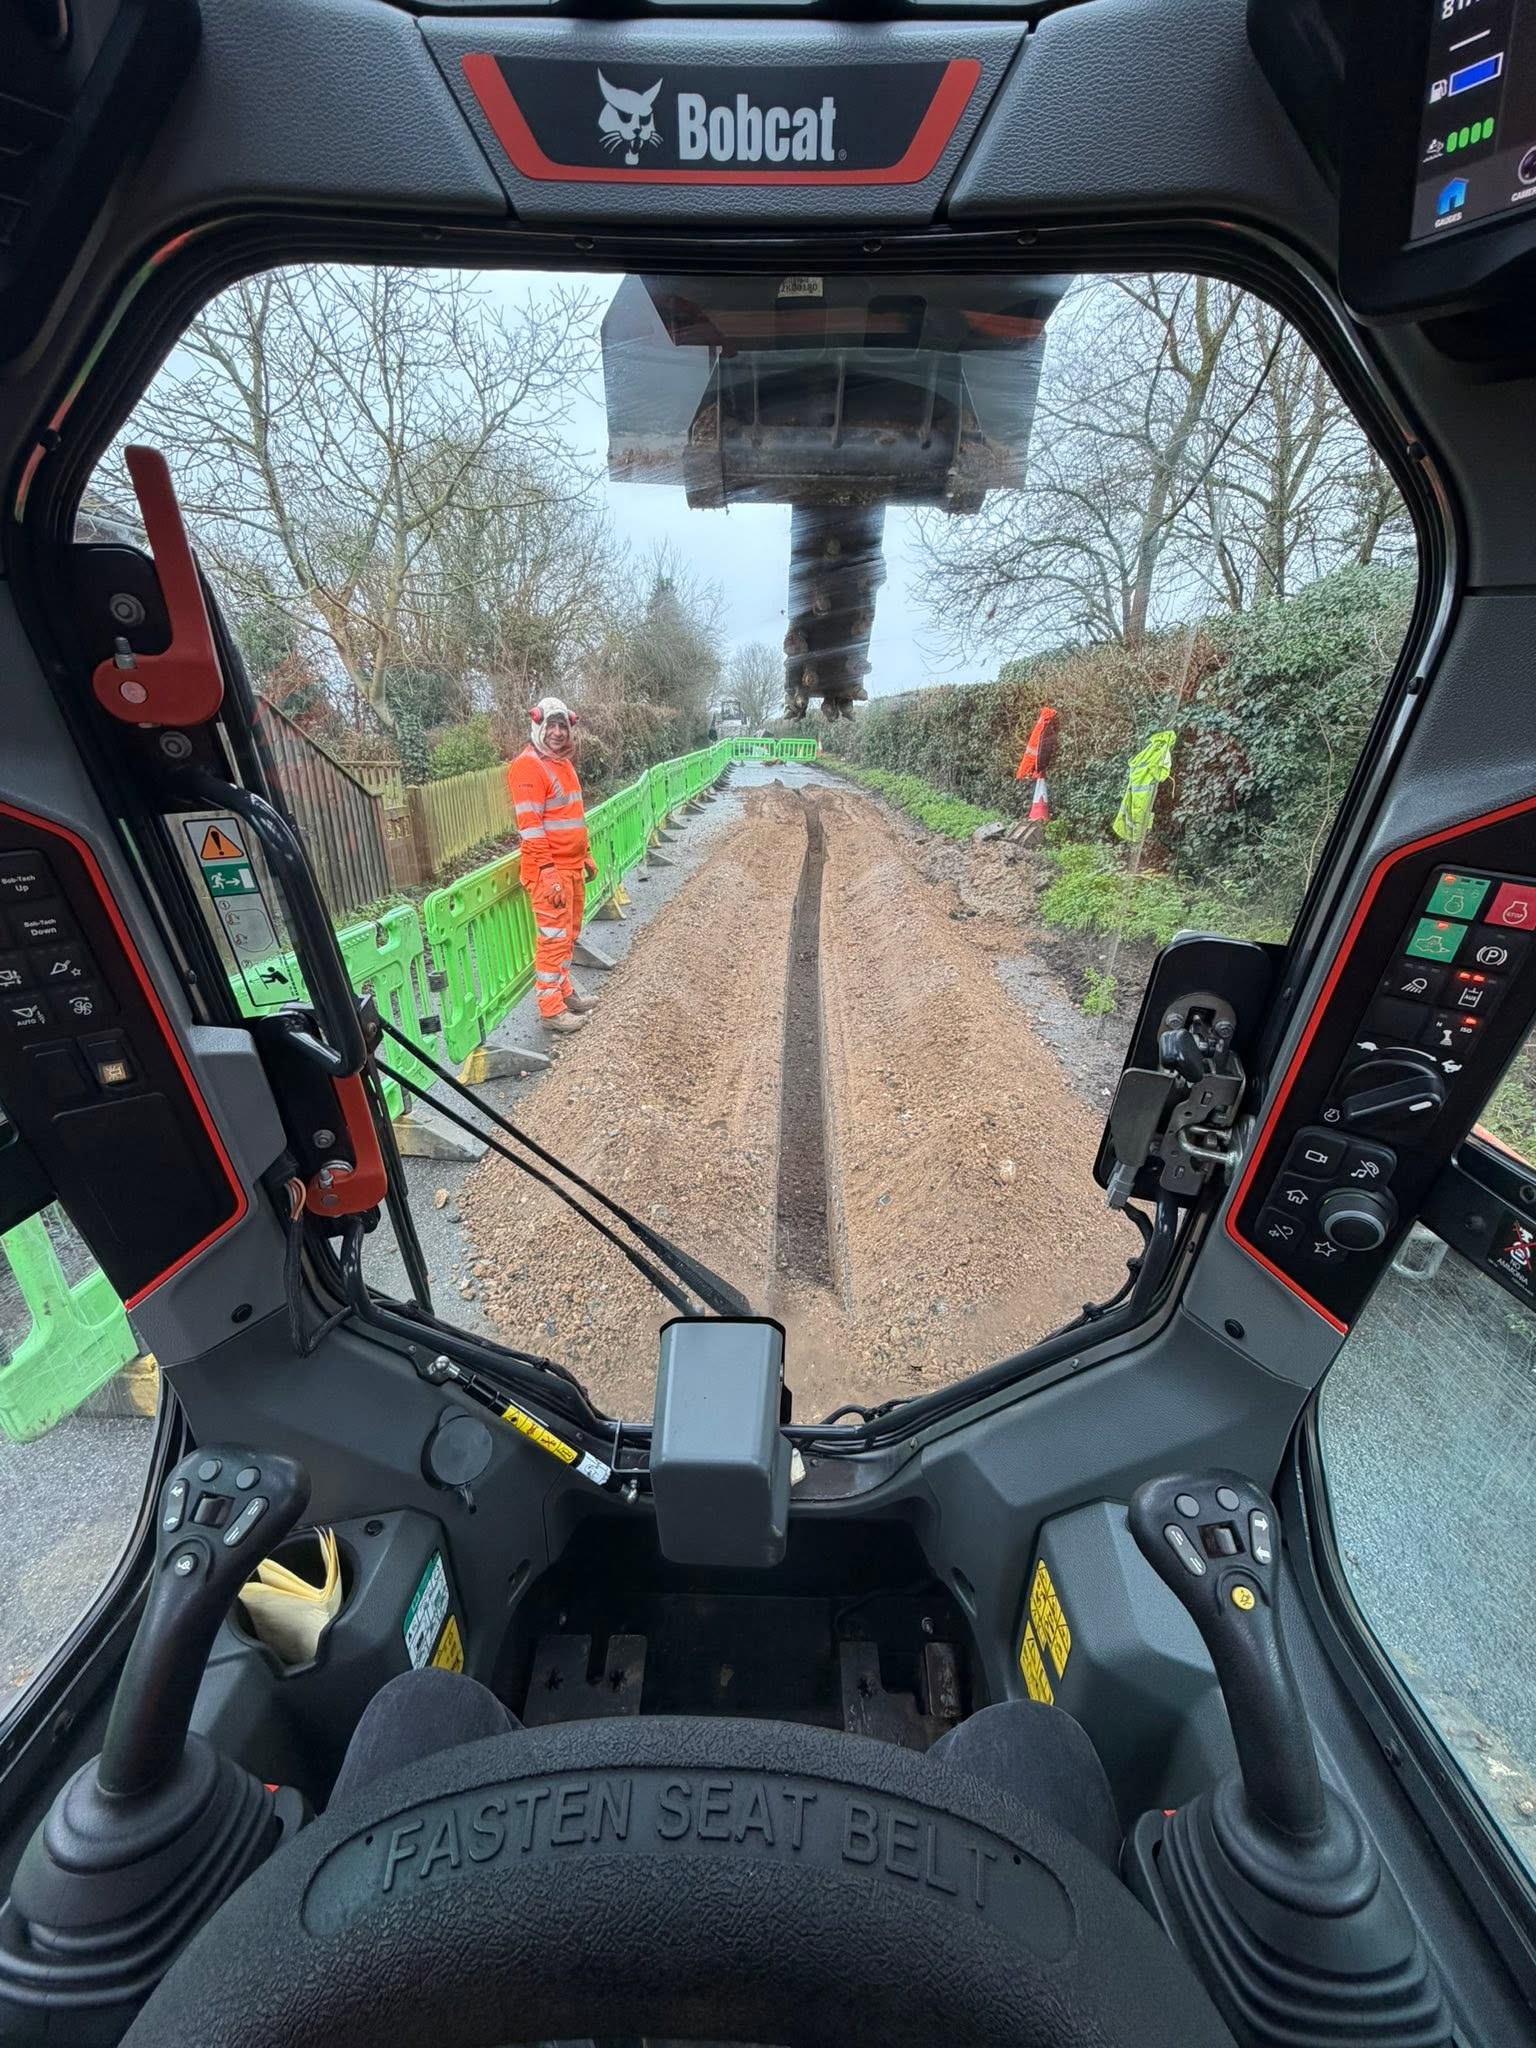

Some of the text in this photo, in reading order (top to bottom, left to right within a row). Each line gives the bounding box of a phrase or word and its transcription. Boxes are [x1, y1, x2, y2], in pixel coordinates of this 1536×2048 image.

[677, 93, 836, 162] Bobcat
[30, 928, 57, 936] Down
[1485, 950, 1499, 961] P
[17, 1018, 37, 1026] AUTO
[1460, 1026, 1472, 1034] ISO
[1510, 1259, 1521, 1271] NO
[1497, 1258, 1529, 1286] AMMONIA
[382, 1777, 997, 1910] FASTEN SEAT BELT
